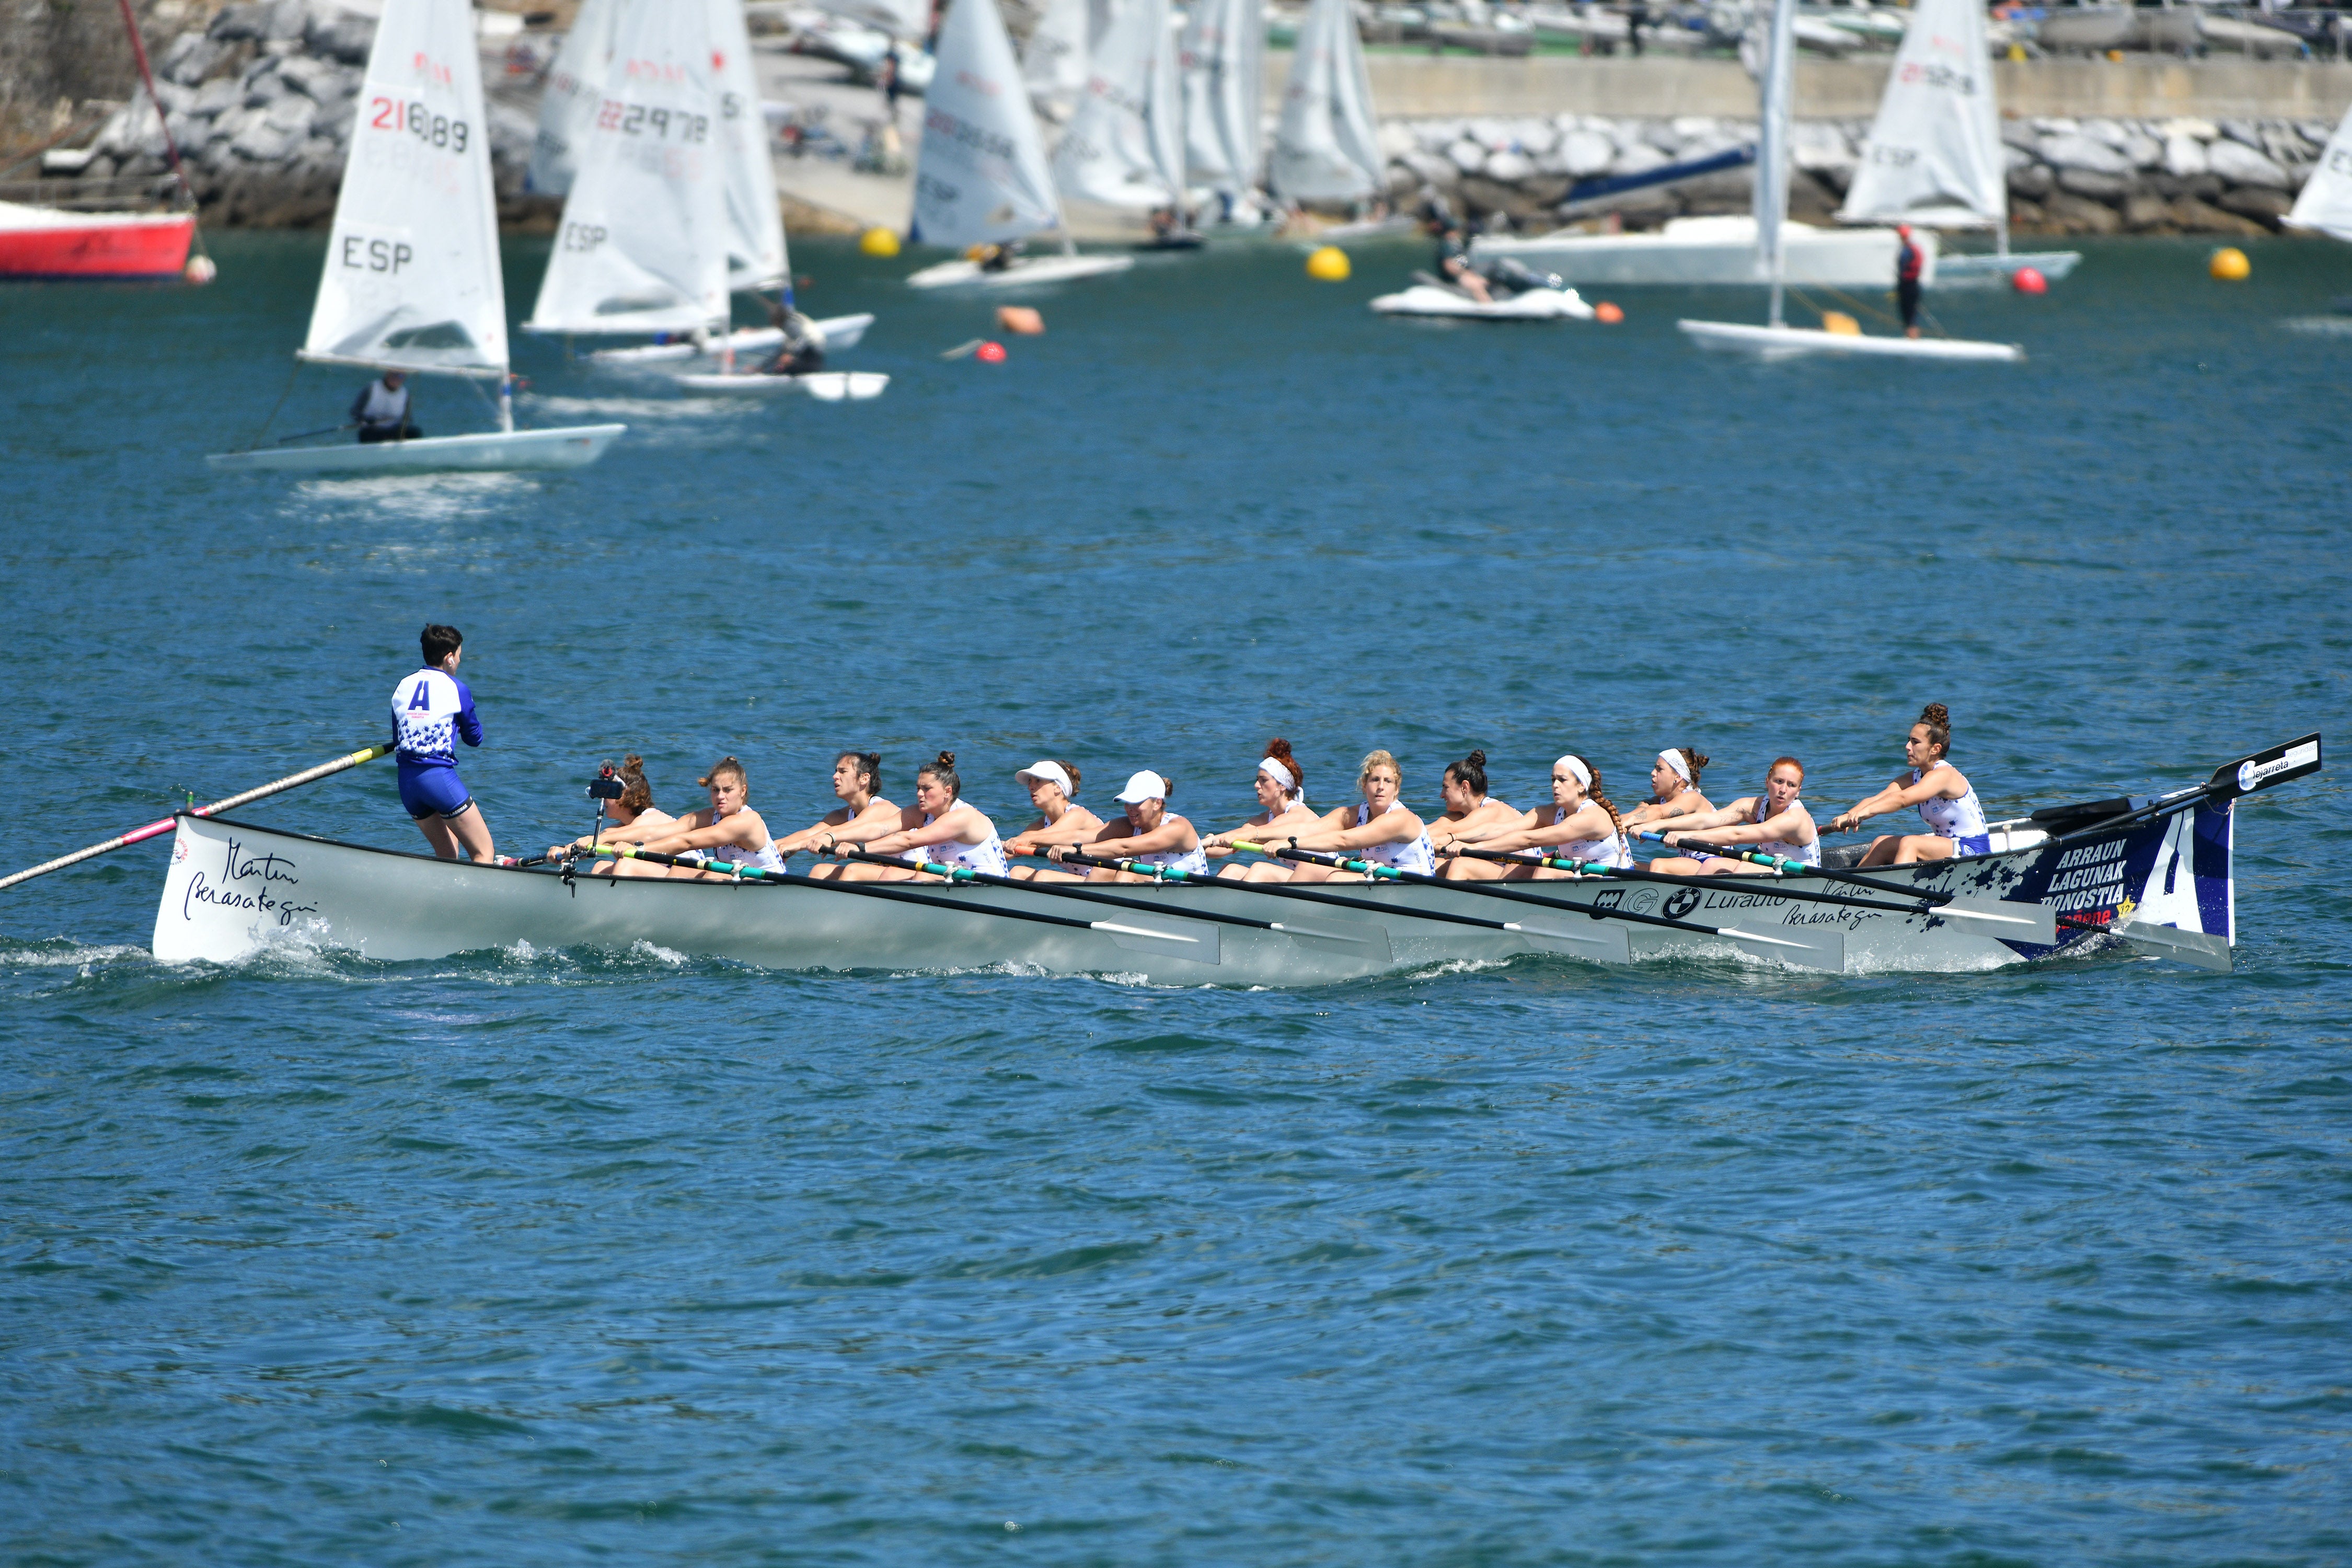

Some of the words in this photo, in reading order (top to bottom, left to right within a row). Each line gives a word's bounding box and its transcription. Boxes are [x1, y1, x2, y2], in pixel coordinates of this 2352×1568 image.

[564, 222, 608, 254] ESP
[343, 236, 412, 275] ESP
[408, 681, 430, 711] A
[2287, 743, 2316, 757] seguridad
[2056, 838, 2127, 869] ARRAUN
[2047, 860, 2127, 893] LAGUNAK
[1673, 888, 1700, 898] BMW
[2042, 883, 2124, 912] DONOSTIA
